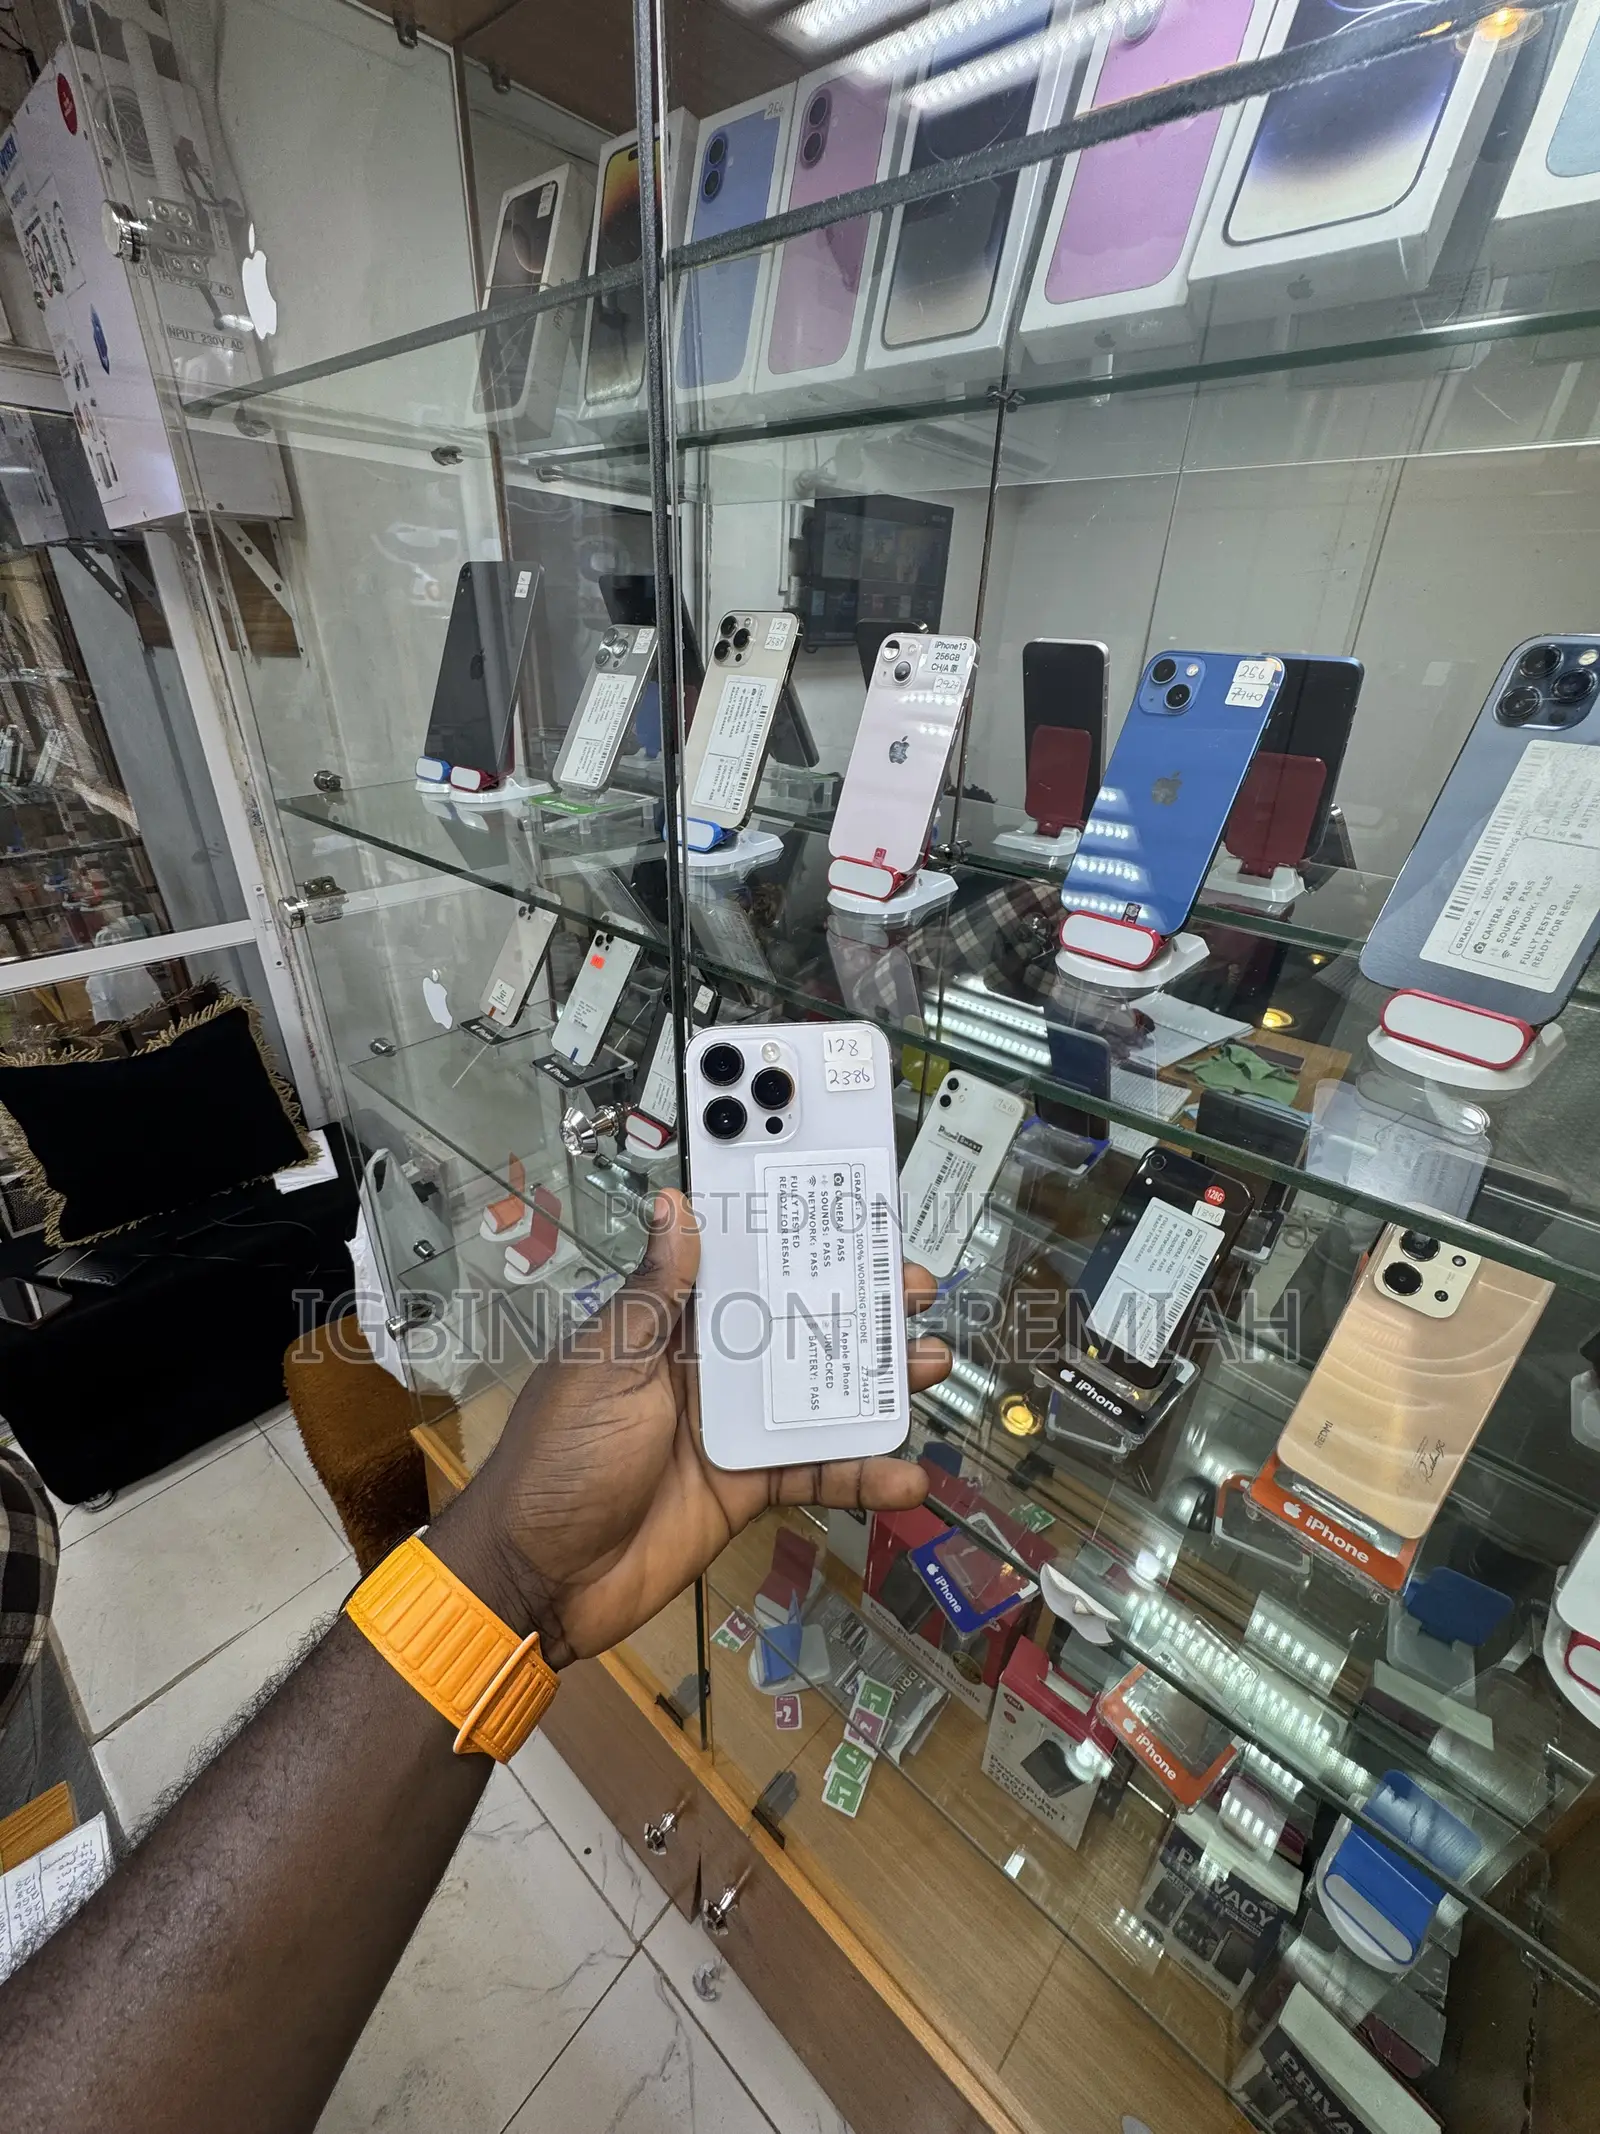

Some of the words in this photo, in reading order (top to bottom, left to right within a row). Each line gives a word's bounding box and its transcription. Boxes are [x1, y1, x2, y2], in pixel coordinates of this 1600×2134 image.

[771, 621, 787, 631] 128
[934, 641, 966, 650] iPhone13
[934, 652, 959, 661] 256GB
[931, 663, 948, 673] CH/A
[1238, 665, 1265, 680] 256
[1455, 916, 1476, 949] GRADE:
[1472, 907, 1481, 916] A
[1480, 875, 1498, 901] 100%
[1493, 835, 1519, 876] WORKING
[1481, 903, 1505, 941] CAMERA:
[1501, 879, 1518, 902] PASS
[1495, 904, 1521, 945] SOUNDS:
[1517, 878, 1535, 903] PASS
[1508, 898, 1539, 949] NETWORK:
[1535, 873, 1553, 898] PASS
[1531, 937, 1552, 969] READY
[1547, 916, 1564, 938] FOR
[1558, 880, 1583, 918] RESALE
[1519, 937, 1539, 966] FULLY
[1534, 902, 1558, 937] TESTED
[829, 1038, 859, 1056] 128
[827, 1067, 870, 1087] 2386
[776, 1176, 788, 1210] READY
[788, 1175, 799, 1206] FULLY
[851, 1171, 863, 1210] GRADE:
[1206, 1189, 1223, 1202] 128G
[779, 1213, 789, 1234] FOR
[805, 1191, 818, 1246] NETWORK:
[818, 1190, 831, 1236] SOUNDS:
[832, 1189, 844, 1232] CAMERA:
[854, 1212, 862, 1221] A
[789, 1209, 801, 1249] TESTED
[854, 1233, 865, 1260] 100%
[779, 1237, 791, 1276] RESALE
[808, 1252, 818, 1277] PASS
[821, 1242, 831, 1267] PASS
[835, 1238, 845, 1262] PASS
[855, 1262, 868, 1309] WORKING
[837, 1331, 850, 1360] Apple
[857, 1312, 868, 1344] PHONE
[805, 1335, 819, 1380] BATTERY:
[821, 1333, 835, 1389] UNLOCKED
[840, 1362, 852, 1396] iPhone
[859, 1365, 871, 1404] 2734437
[809, 1386, 819, 1410] PASS
[1074, 1378, 1124, 1417] iPhone
[1313, 1419, 1333, 1448] REDMI
[1304, 1515, 1372, 1564] iPhone
[933, 1574, 964, 1613] iPhone
[890, 1665, 919, 1707] PRIV
[782, 1705, 791, 1722] 2
[1134, 1732, 1178, 1781] iPhone
[989, 1753, 1059, 1817] PowerPulse
